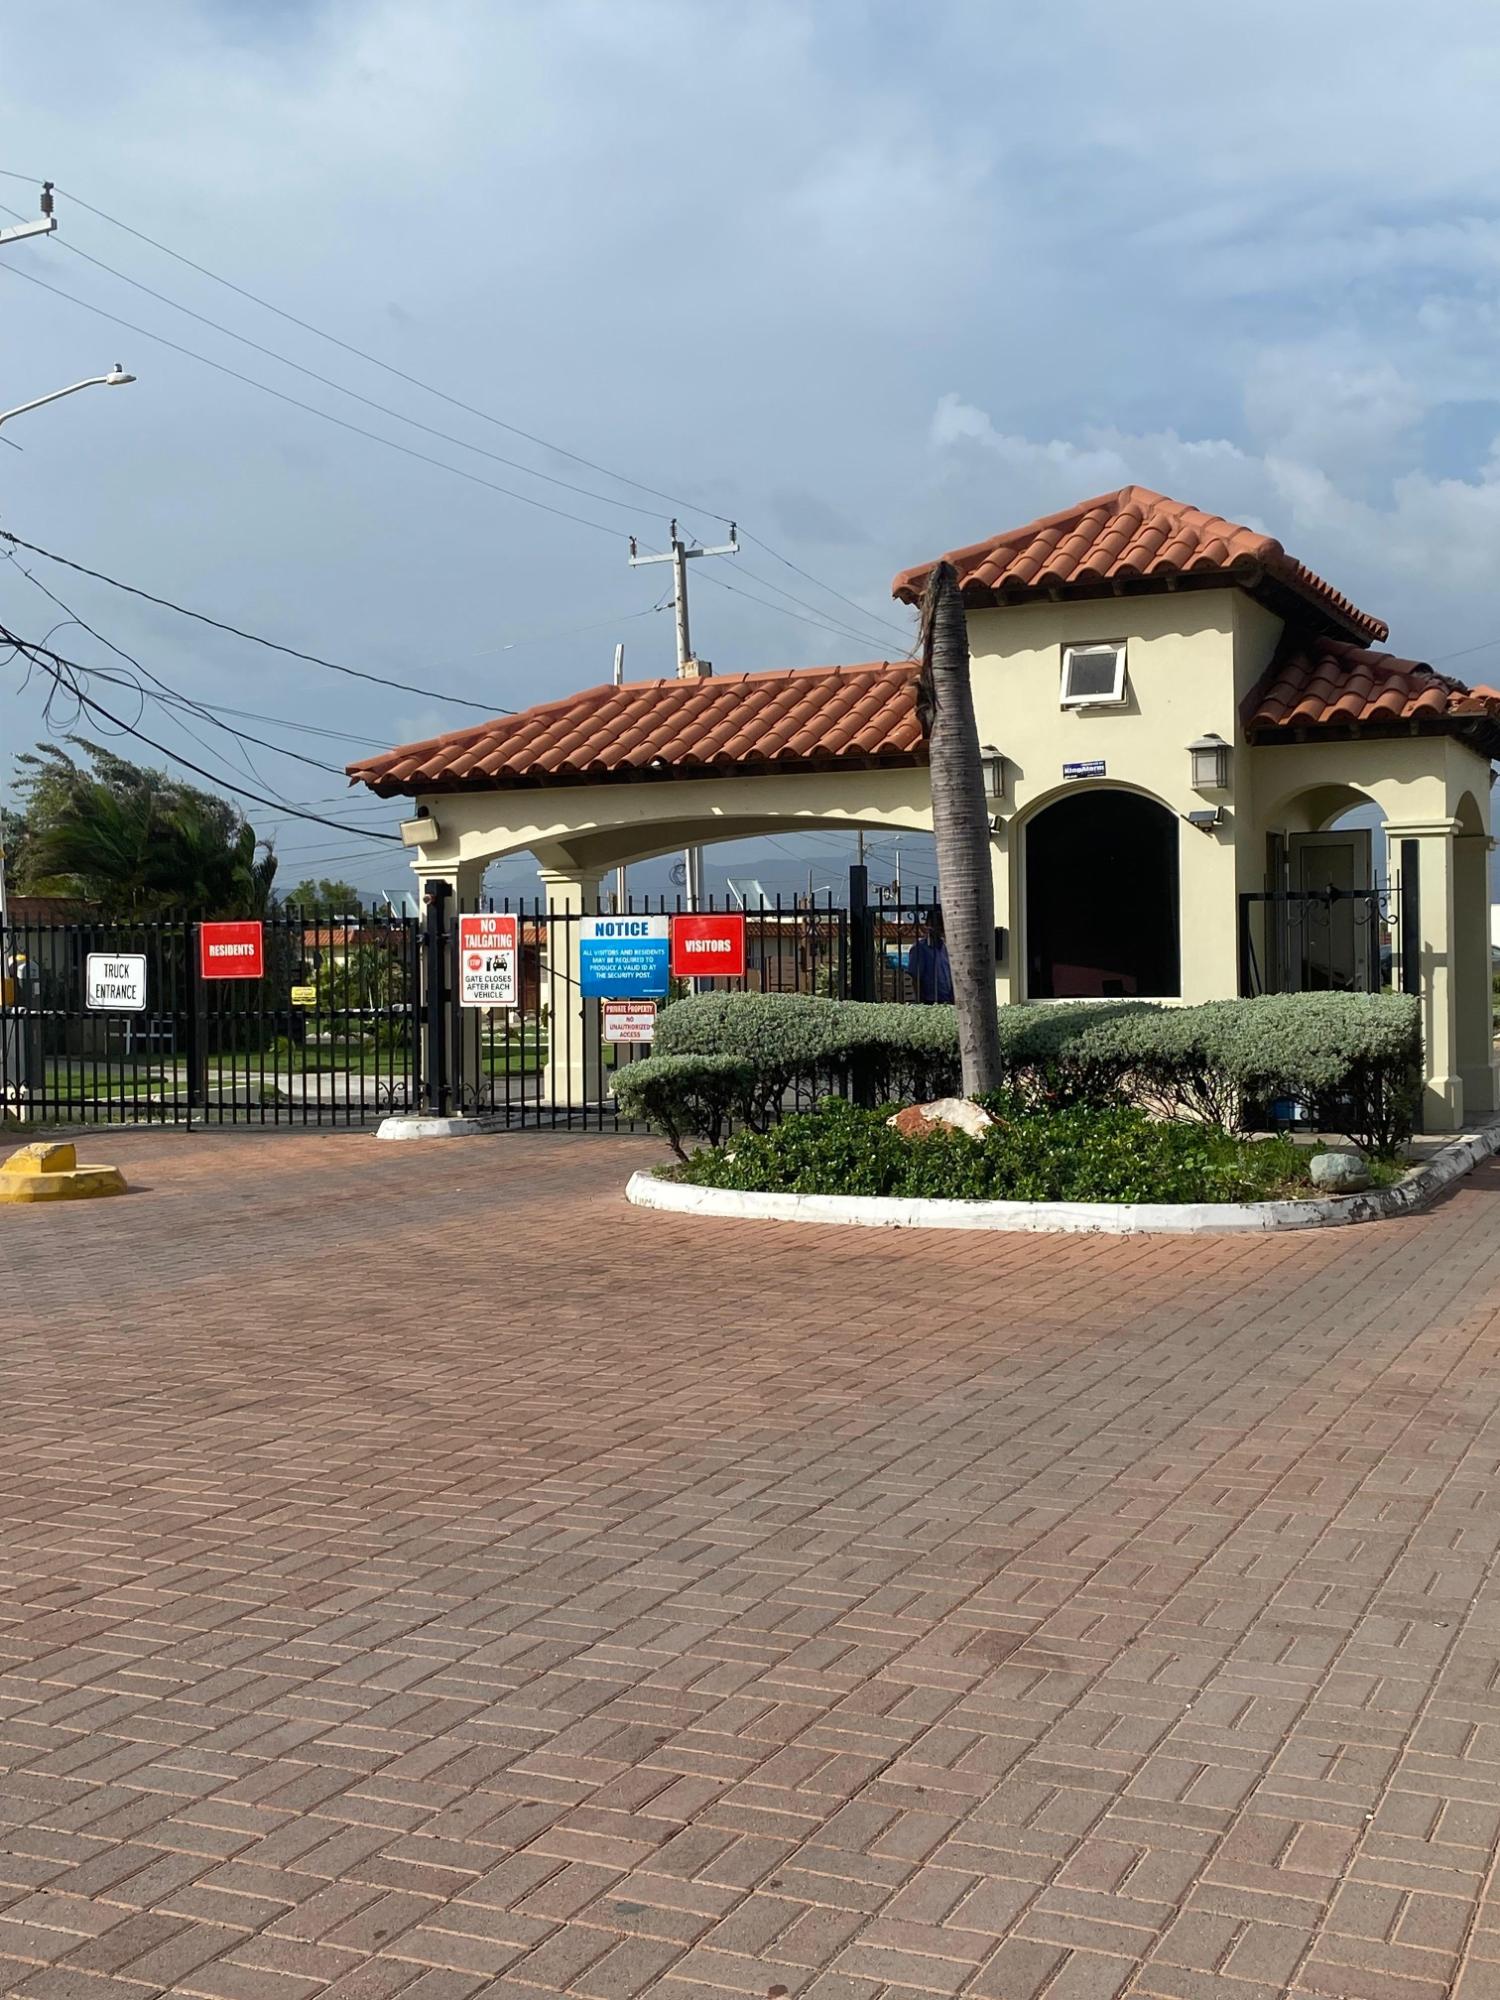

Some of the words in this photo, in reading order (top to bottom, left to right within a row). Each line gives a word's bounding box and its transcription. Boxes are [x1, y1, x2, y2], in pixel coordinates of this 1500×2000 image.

[480, 919, 496, 933] NO
[595, 922, 649, 937] NOTICE
[464, 933, 512, 948] TAILGATING
[685, 939, 731, 953] VISITORS
[209, 943, 255, 957] RESIDENTS
[469, 959, 481, 967] STOP
[104, 963, 129, 979] TRUCK
[96, 984, 137, 1000] ENTRANCE
[606, 1005, 627, 1013] PRIVATE
[628, 1005, 653, 1013] PROPERTY
